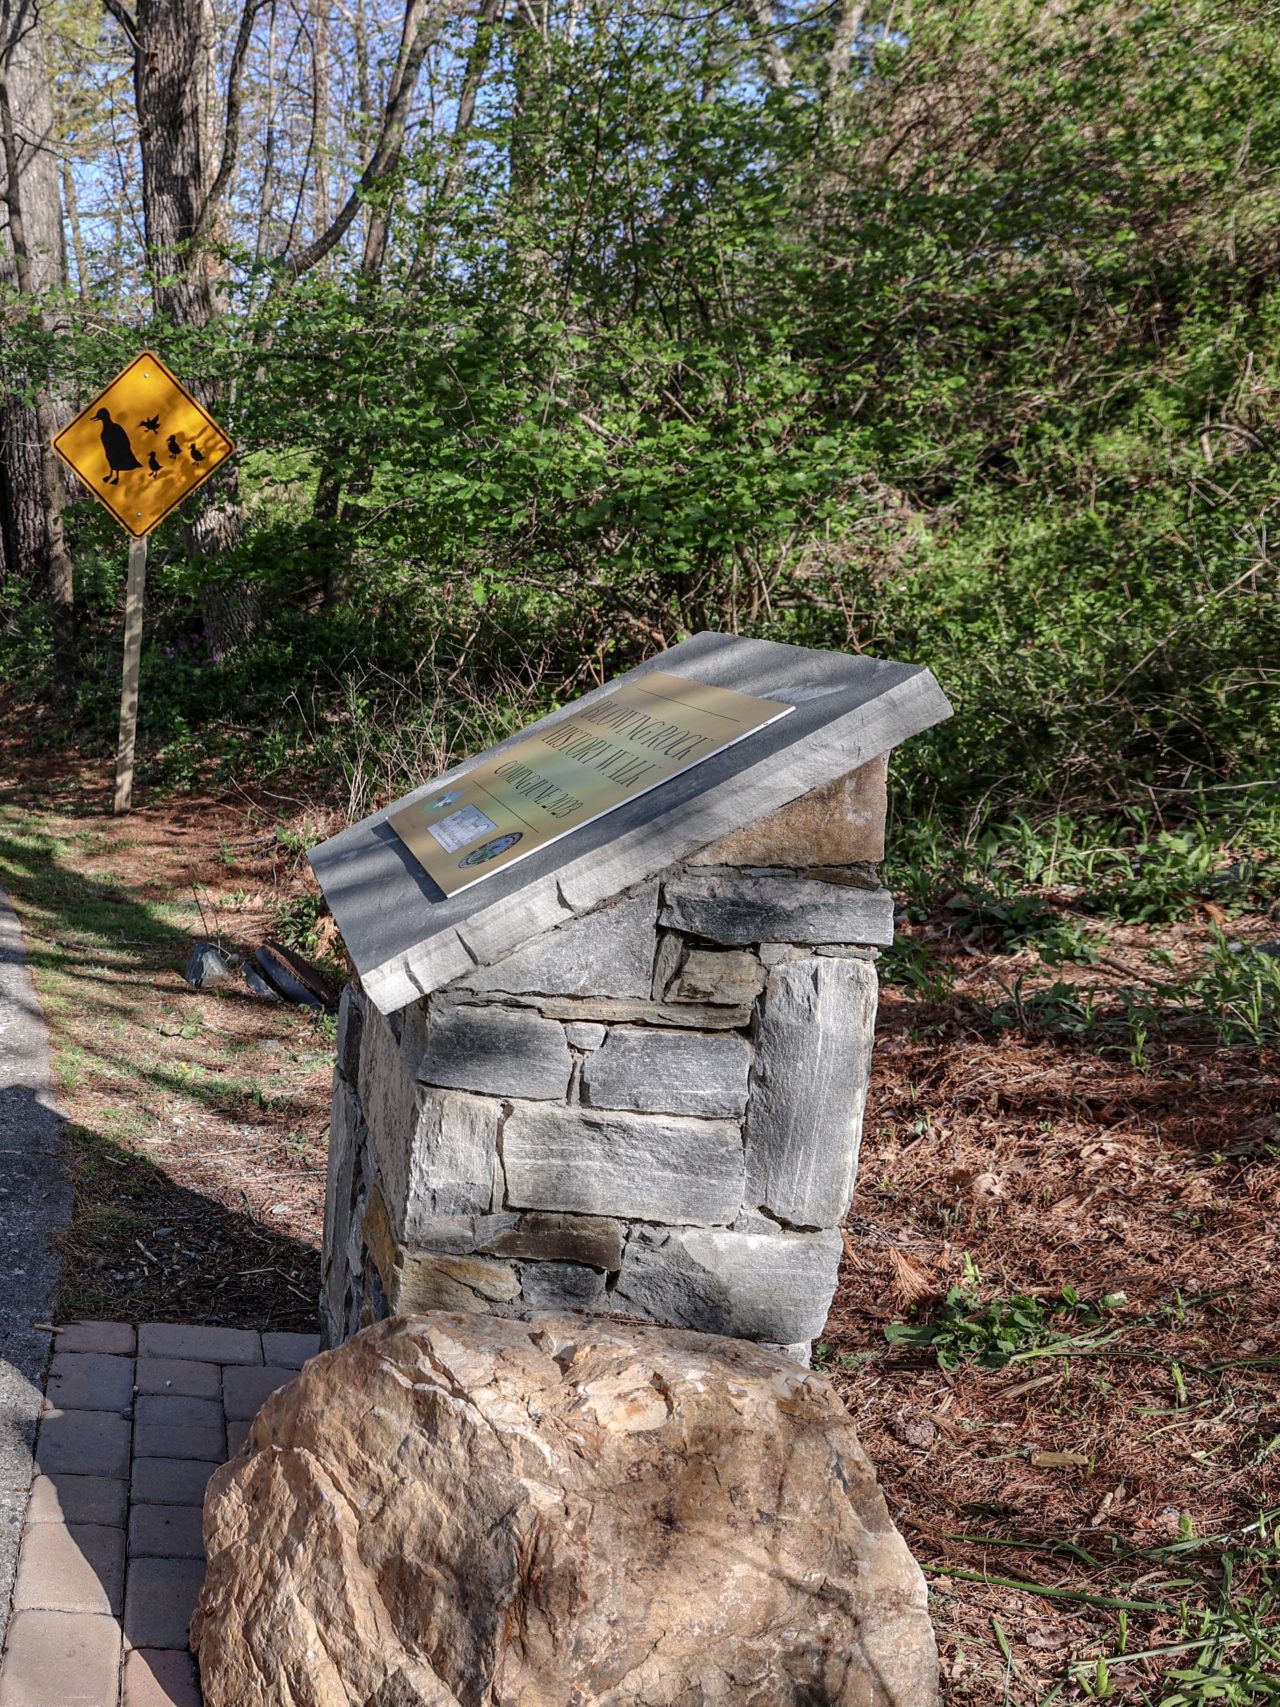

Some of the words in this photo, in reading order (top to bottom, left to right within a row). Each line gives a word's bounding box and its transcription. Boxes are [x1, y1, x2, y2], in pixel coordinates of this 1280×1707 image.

[541, 724, 616, 764] HISTORY
[597, 748, 662, 788] WALK
[581, 700, 664, 742] BLOWING
[641, 725, 714, 761] ROCK
[494, 760, 540, 792] COMING
[519, 780, 562, 805] JUNE
[541, 793, 584, 819] 2023
